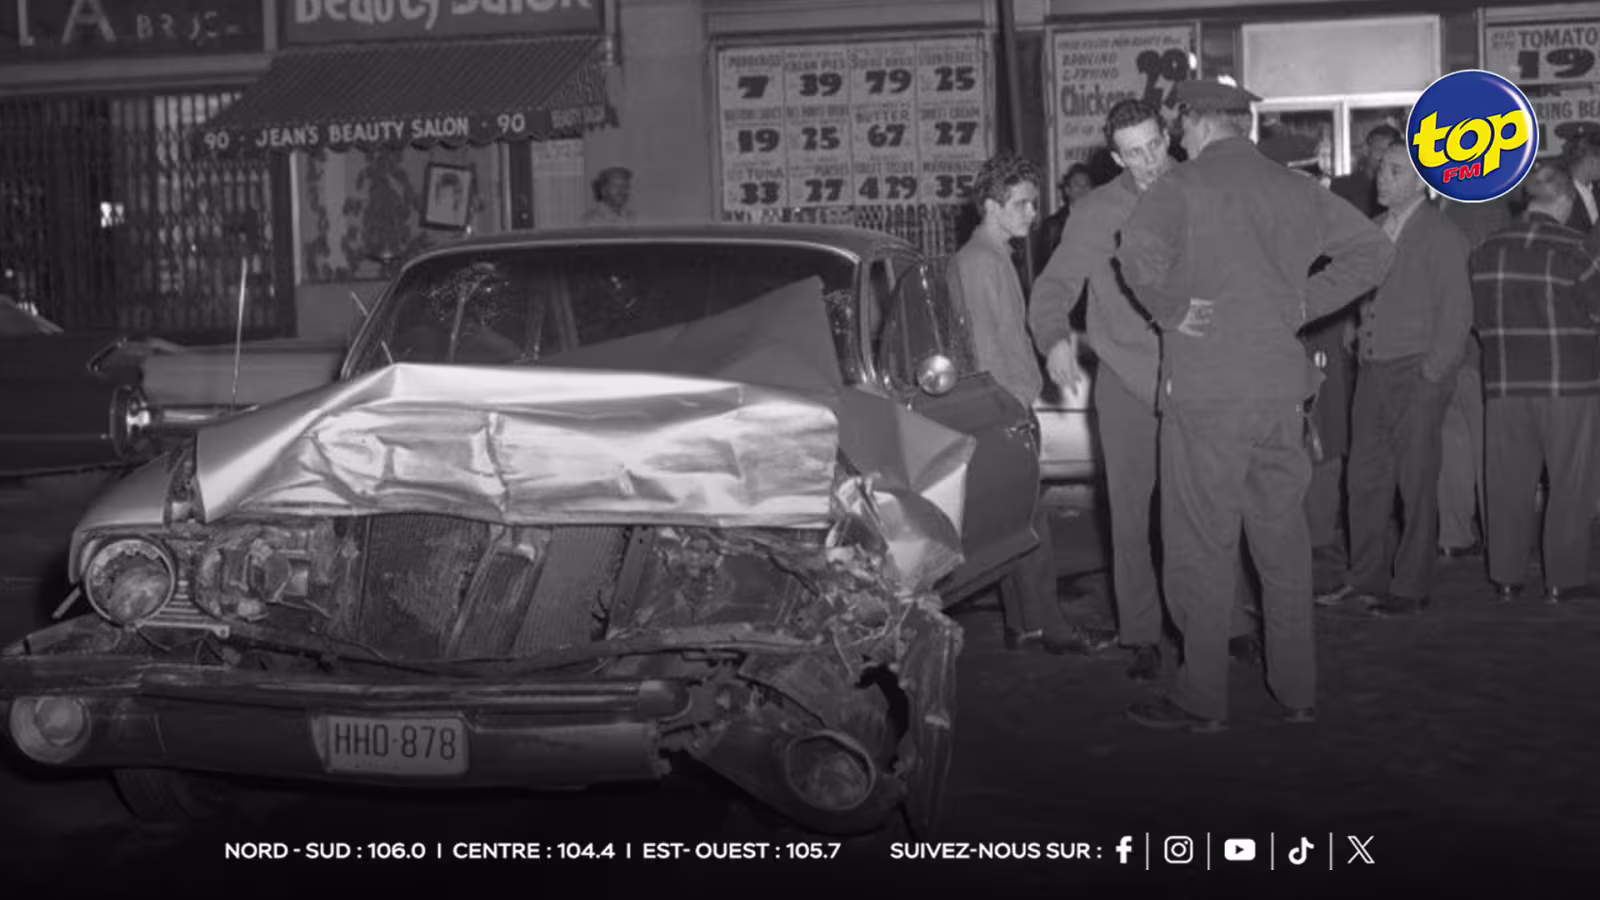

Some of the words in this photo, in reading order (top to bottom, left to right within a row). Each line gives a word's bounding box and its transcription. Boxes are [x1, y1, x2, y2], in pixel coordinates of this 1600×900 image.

[1518, 47, 1596, 80] 19
[737, 75, 770, 99] 7
[799, 72, 844, 97] 39
[864, 67, 913, 95] 79
[934, 65, 977, 92] 25
[203, 130, 230, 151] 90
[255, 124, 319, 148] JEAN'S
[329, 120, 404, 144] BEAUTY
[410, 116, 470, 140] SALON
[496, 112, 526, 133] 90
[737, 128, 781, 154] 19
[801, 125, 841, 152] 25
[867, 122, 907, 149] 67
[934, 121, 979, 146] 27
[739, 181, 782, 205] 33
[804, 178, 845, 203] 27
[857, 175, 880, 200] 4
[884, 174, 918, 200] 29
[934, 173, 974, 199] 35
